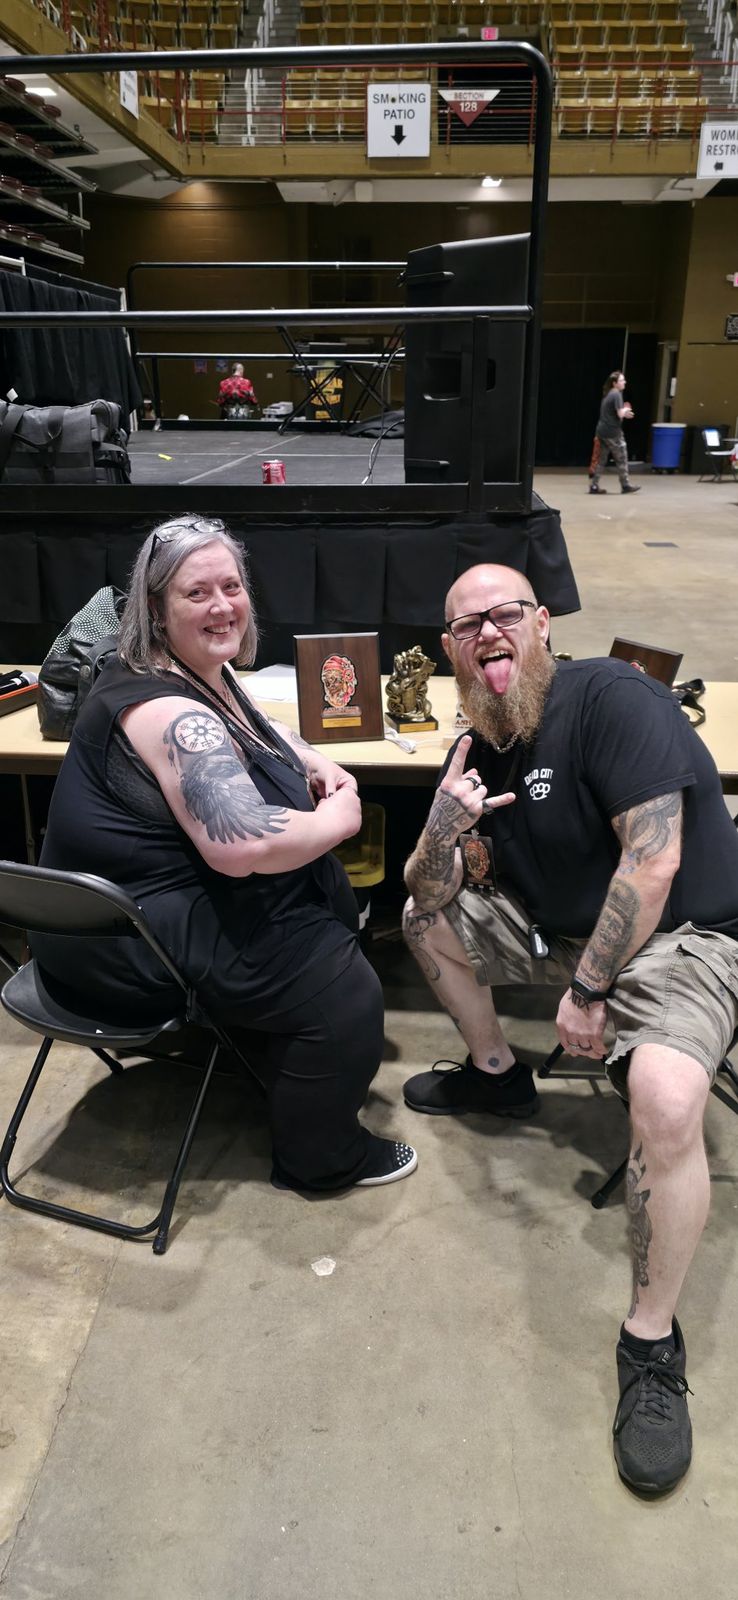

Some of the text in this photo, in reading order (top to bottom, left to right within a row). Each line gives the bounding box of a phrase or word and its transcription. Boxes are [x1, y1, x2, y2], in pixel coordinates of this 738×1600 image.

[372, 92, 426, 104] SMKING
[453, 92, 485, 100] SECTION
[459, 101, 478, 112] 128
[383, 108, 415, 120] PATIO
[706, 144, 738, 156] RESTR
